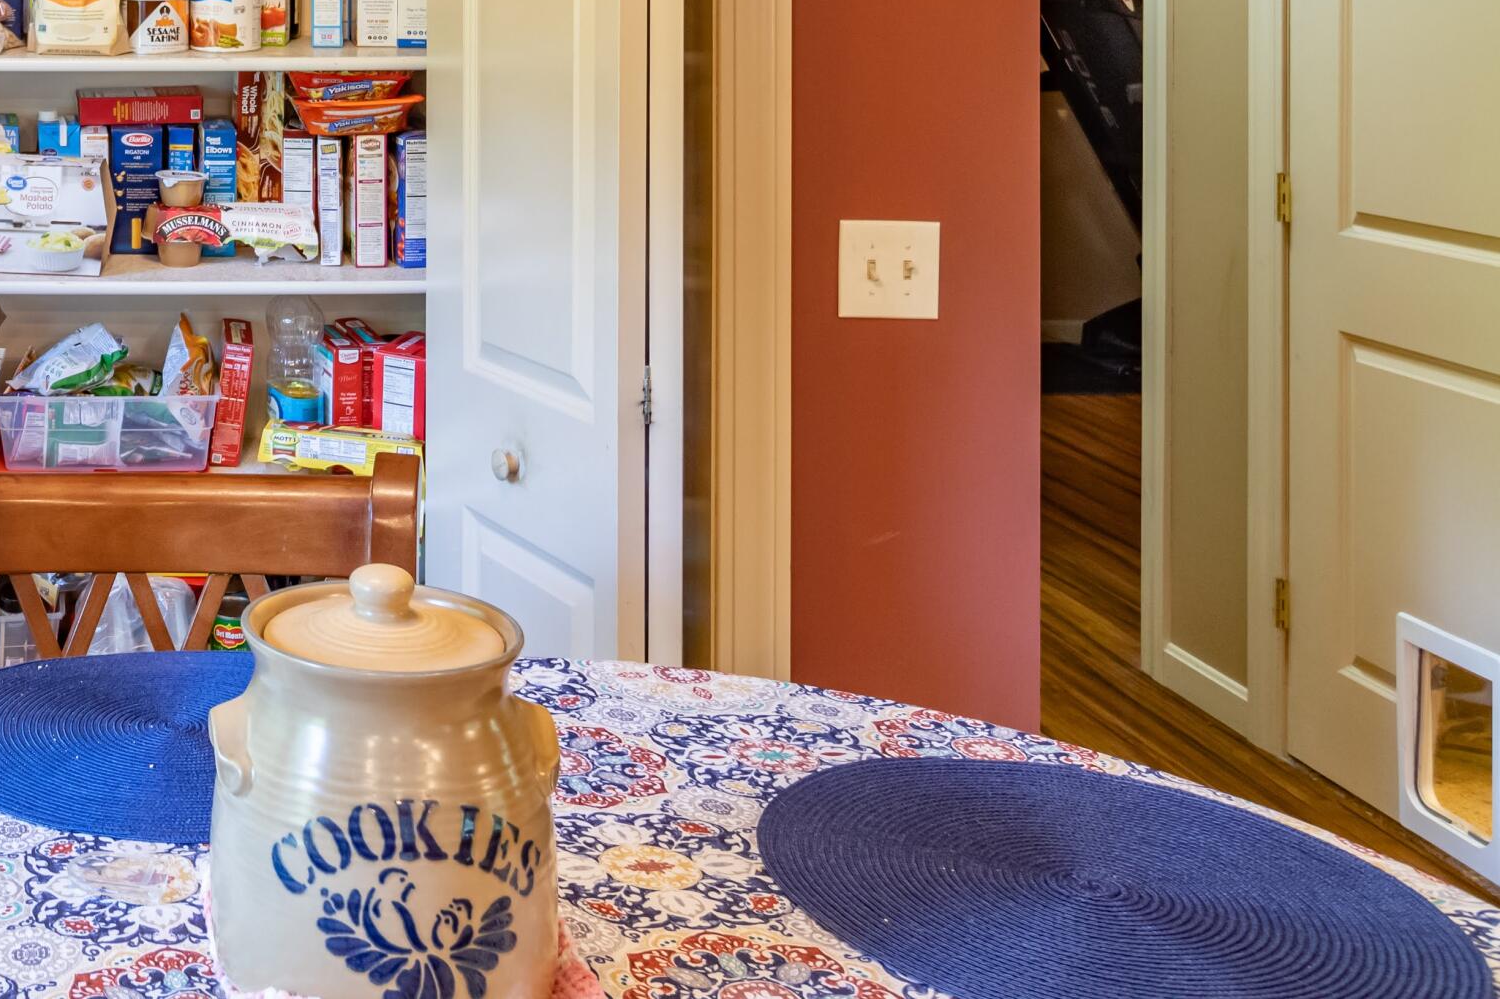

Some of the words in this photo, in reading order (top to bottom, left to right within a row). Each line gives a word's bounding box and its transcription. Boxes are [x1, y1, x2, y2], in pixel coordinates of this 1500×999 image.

[146, 28, 180, 36] SESAME
[150, 35, 180, 43] TAHINI
[328, 83, 370, 95] Yakisoba
[242, 85, 250, 114] Wheat
[250, 85, 258, 114] Whole
[206, 146, 232, 154] Elbows
[20, 194, 54, 202] Mashed
[26, 202, 53, 210] Potato
[232, 220, 282, 230] CINNAMON
[216, 629, 224, 638] Del
[270, 798, 542, 899] COOKIES
